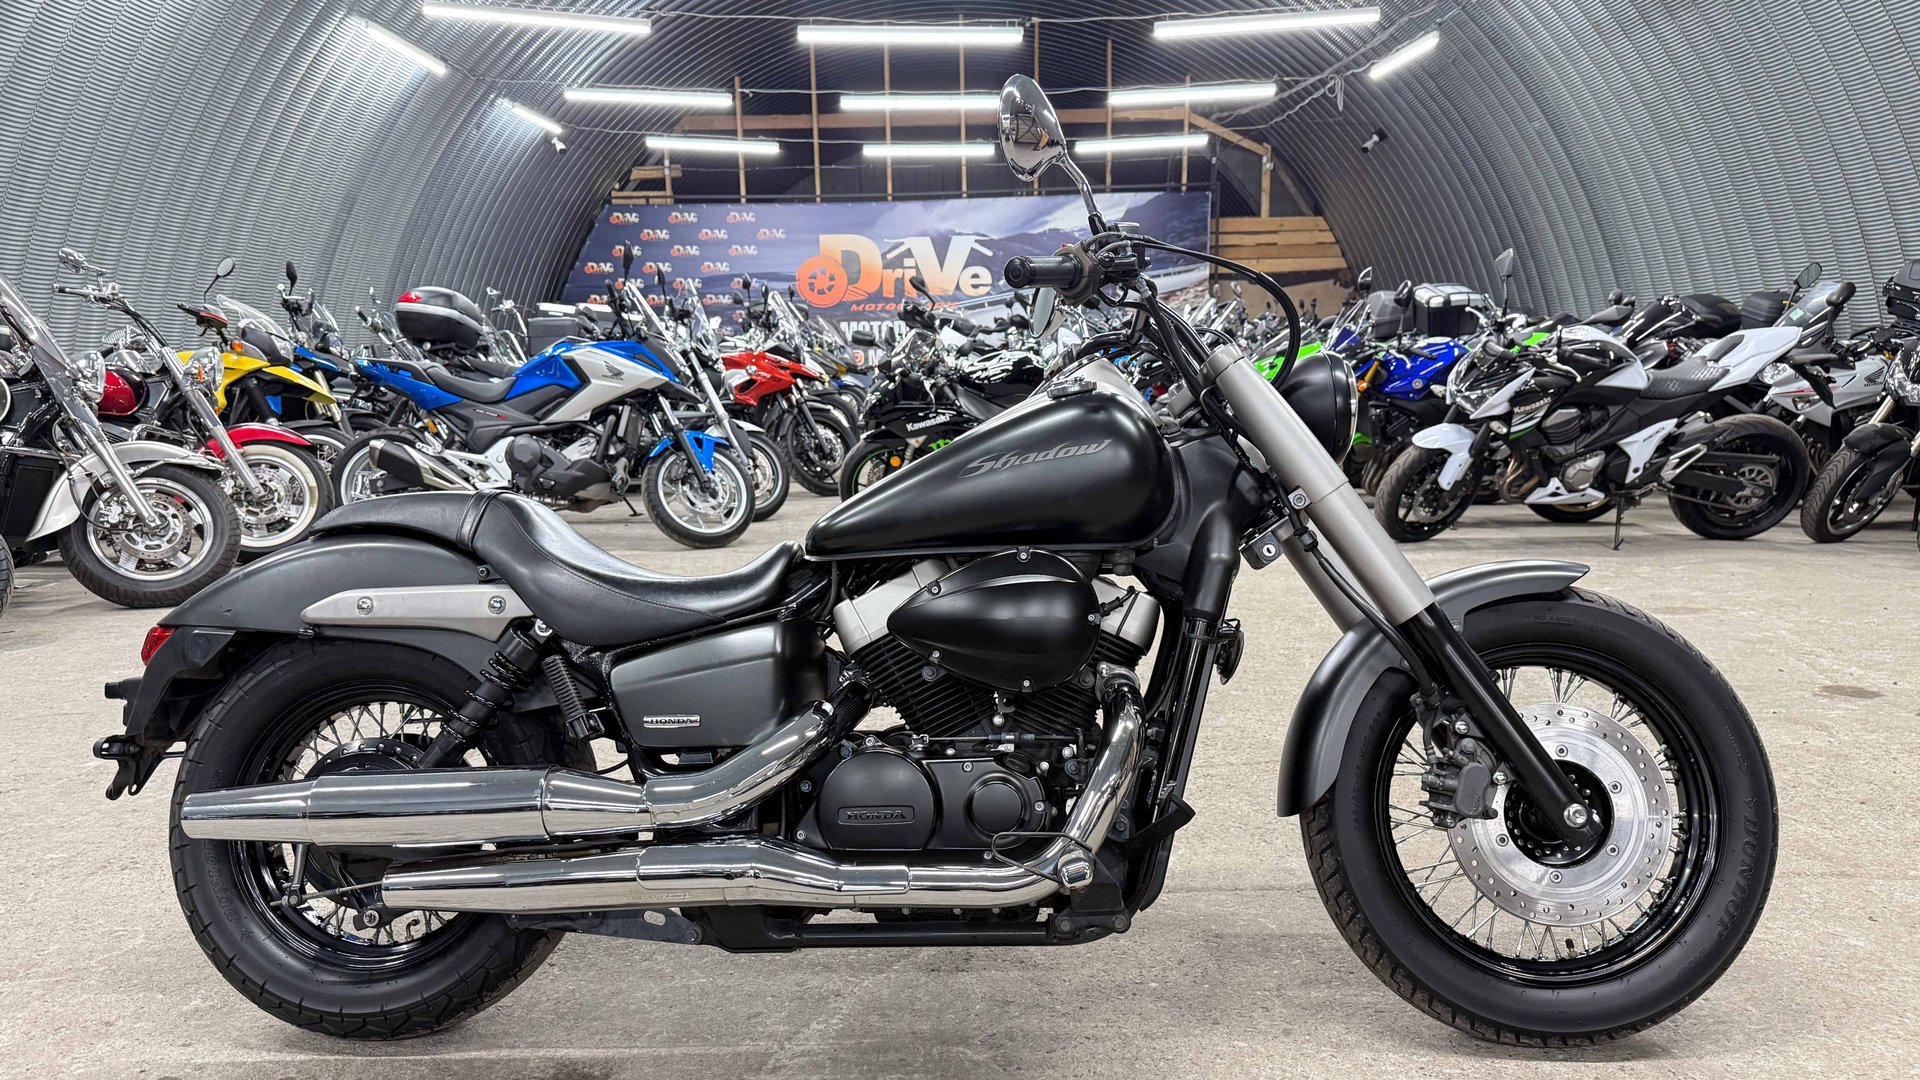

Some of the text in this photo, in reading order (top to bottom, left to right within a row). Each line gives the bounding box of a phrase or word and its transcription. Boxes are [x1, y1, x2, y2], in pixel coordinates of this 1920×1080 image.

[1513, 397, 1551, 413] Kawasaki
[906, 413, 950, 431] Kawasaki
[958, 438, 1113, 478] Shadow
[846, 810, 906, 820] HONDA
[1716, 814, 1760, 942] DUNLOP
